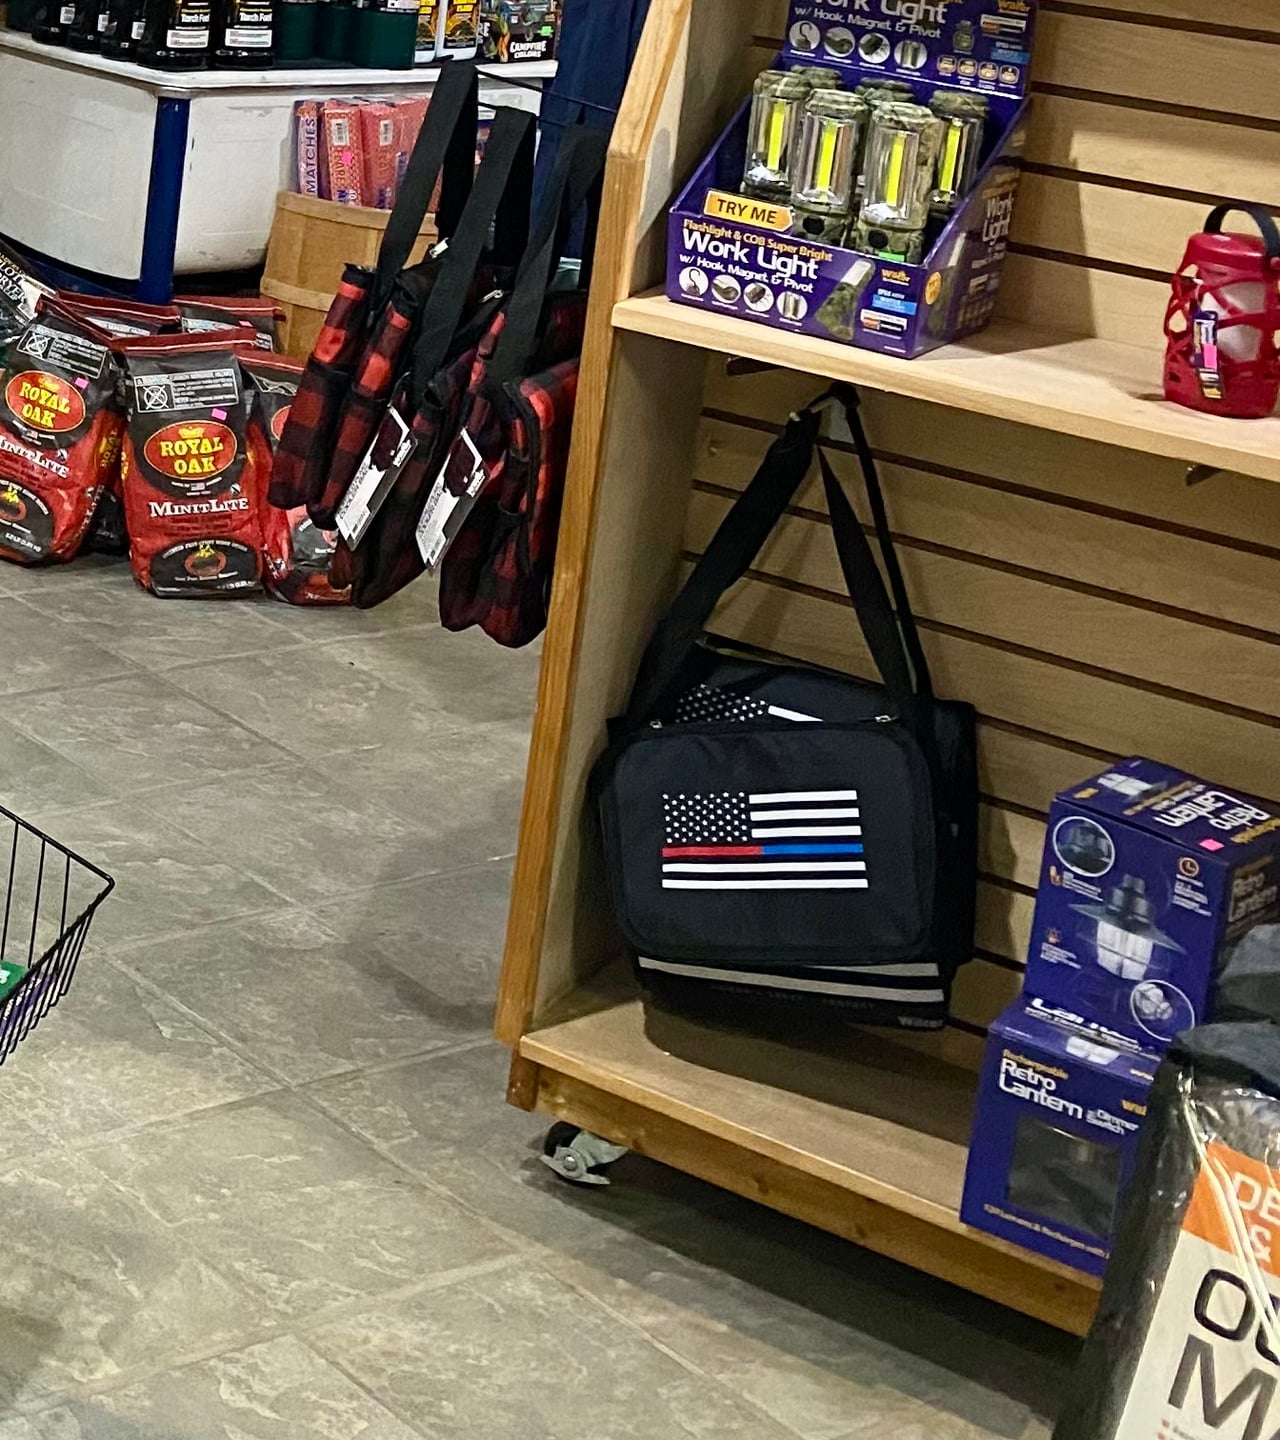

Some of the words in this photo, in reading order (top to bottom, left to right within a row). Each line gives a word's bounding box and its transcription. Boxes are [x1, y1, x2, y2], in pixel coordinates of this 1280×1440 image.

[909, 24, 941, 39] Pivot
[509, 41, 547, 54] CAMPFIRE
[304, 117, 318, 195] MATCHES
[716, 198, 747, 216] TRY
[750, 205, 777, 224] ME
[743, 233, 766, 246] COB
[682, 228, 749, 264] Work
[757, 245, 818, 281] Light
[19, 384, 71, 415] ROYAL
[22, 404, 57, 428] OAK
[160, 435, 225, 457] ROYAL
[173, 454, 216, 474] OAK
[1154, 789, 1240, 829] Lantern
[1001, 1058, 1056, 1092] Retro
[999, 1072, 1083, 1118] Lantern
